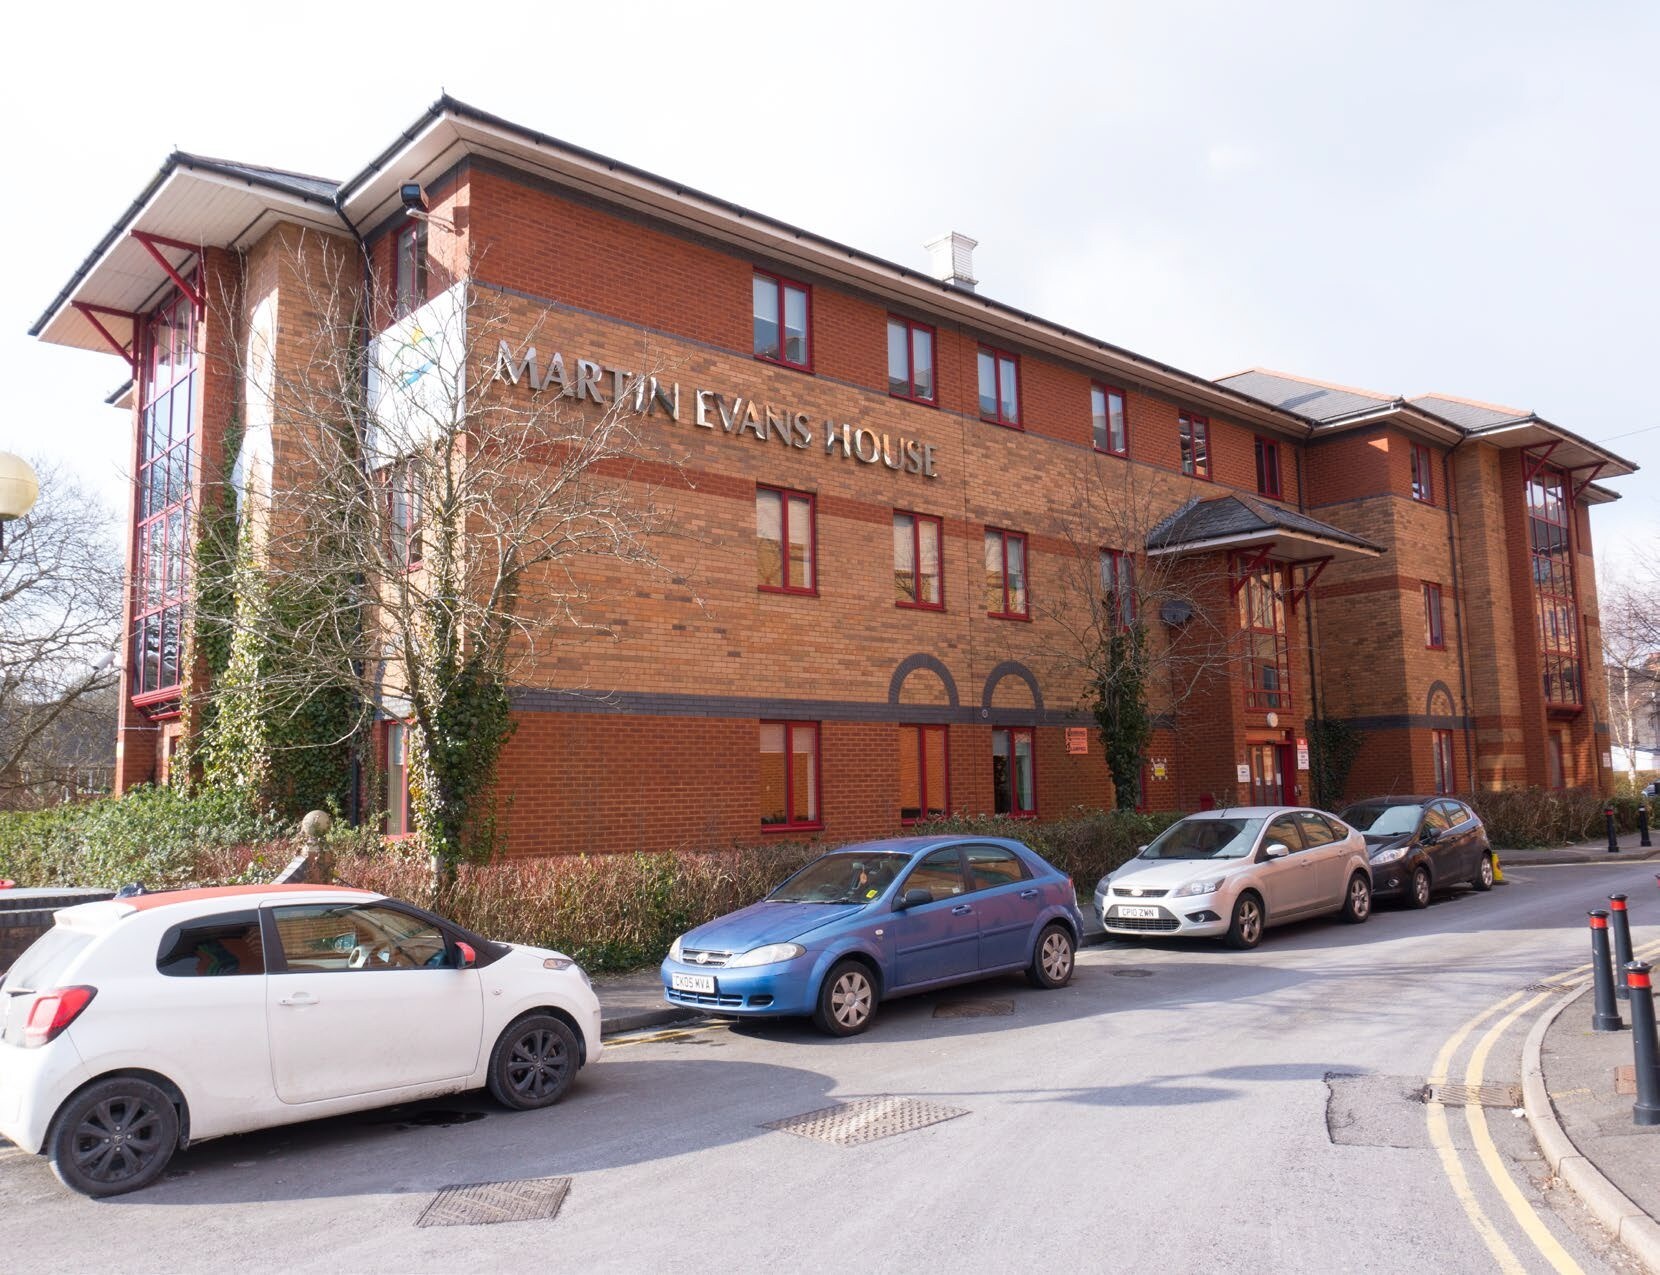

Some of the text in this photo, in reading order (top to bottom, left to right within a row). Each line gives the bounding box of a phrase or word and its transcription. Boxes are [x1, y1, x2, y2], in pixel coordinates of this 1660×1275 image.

[493, 339, 938, 479] MARTIN EVANS HOUSE
[694, 977, 710, 990] MVA
